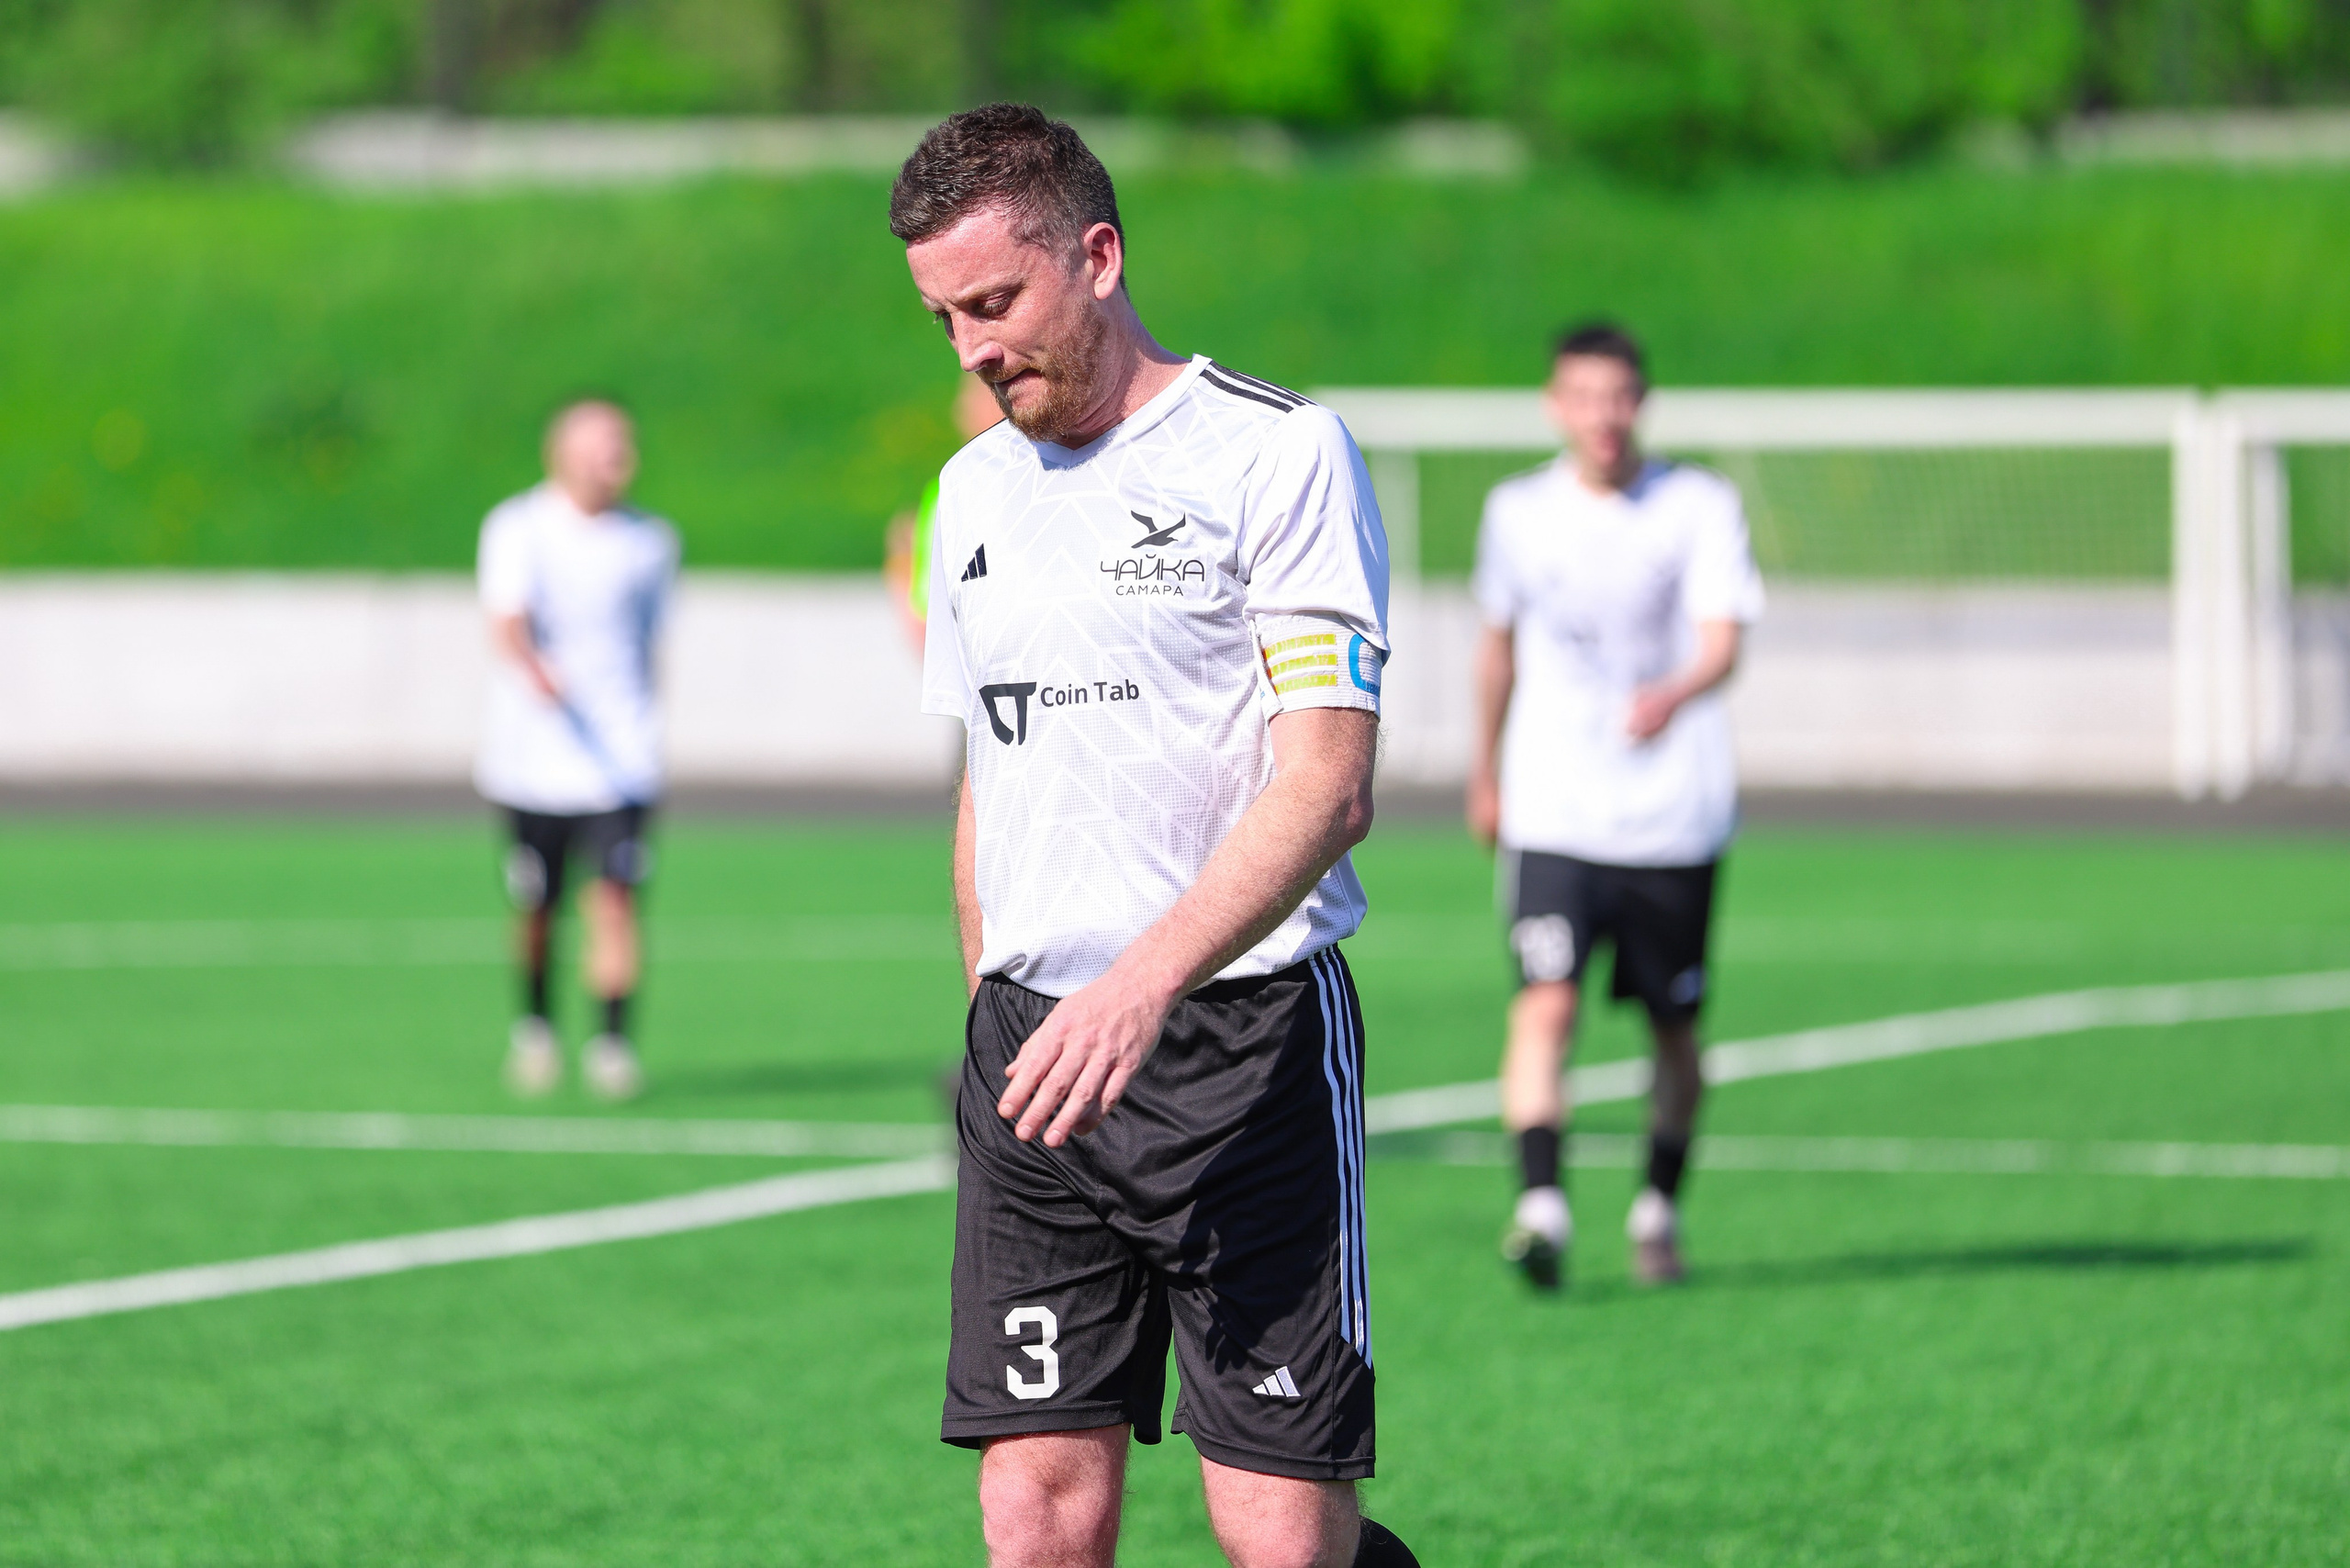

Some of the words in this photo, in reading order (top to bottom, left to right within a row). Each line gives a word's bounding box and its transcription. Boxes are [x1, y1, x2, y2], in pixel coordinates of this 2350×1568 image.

[1101, 554, 1204, 582] ЧАЙКА
[1115, 585, 1184, 597] САМАРА
[1040, 684, 1088, 707] Coin
[1093, 678, 1140, 701] Tab
[1004, 1306, 1060, 1399] 3
